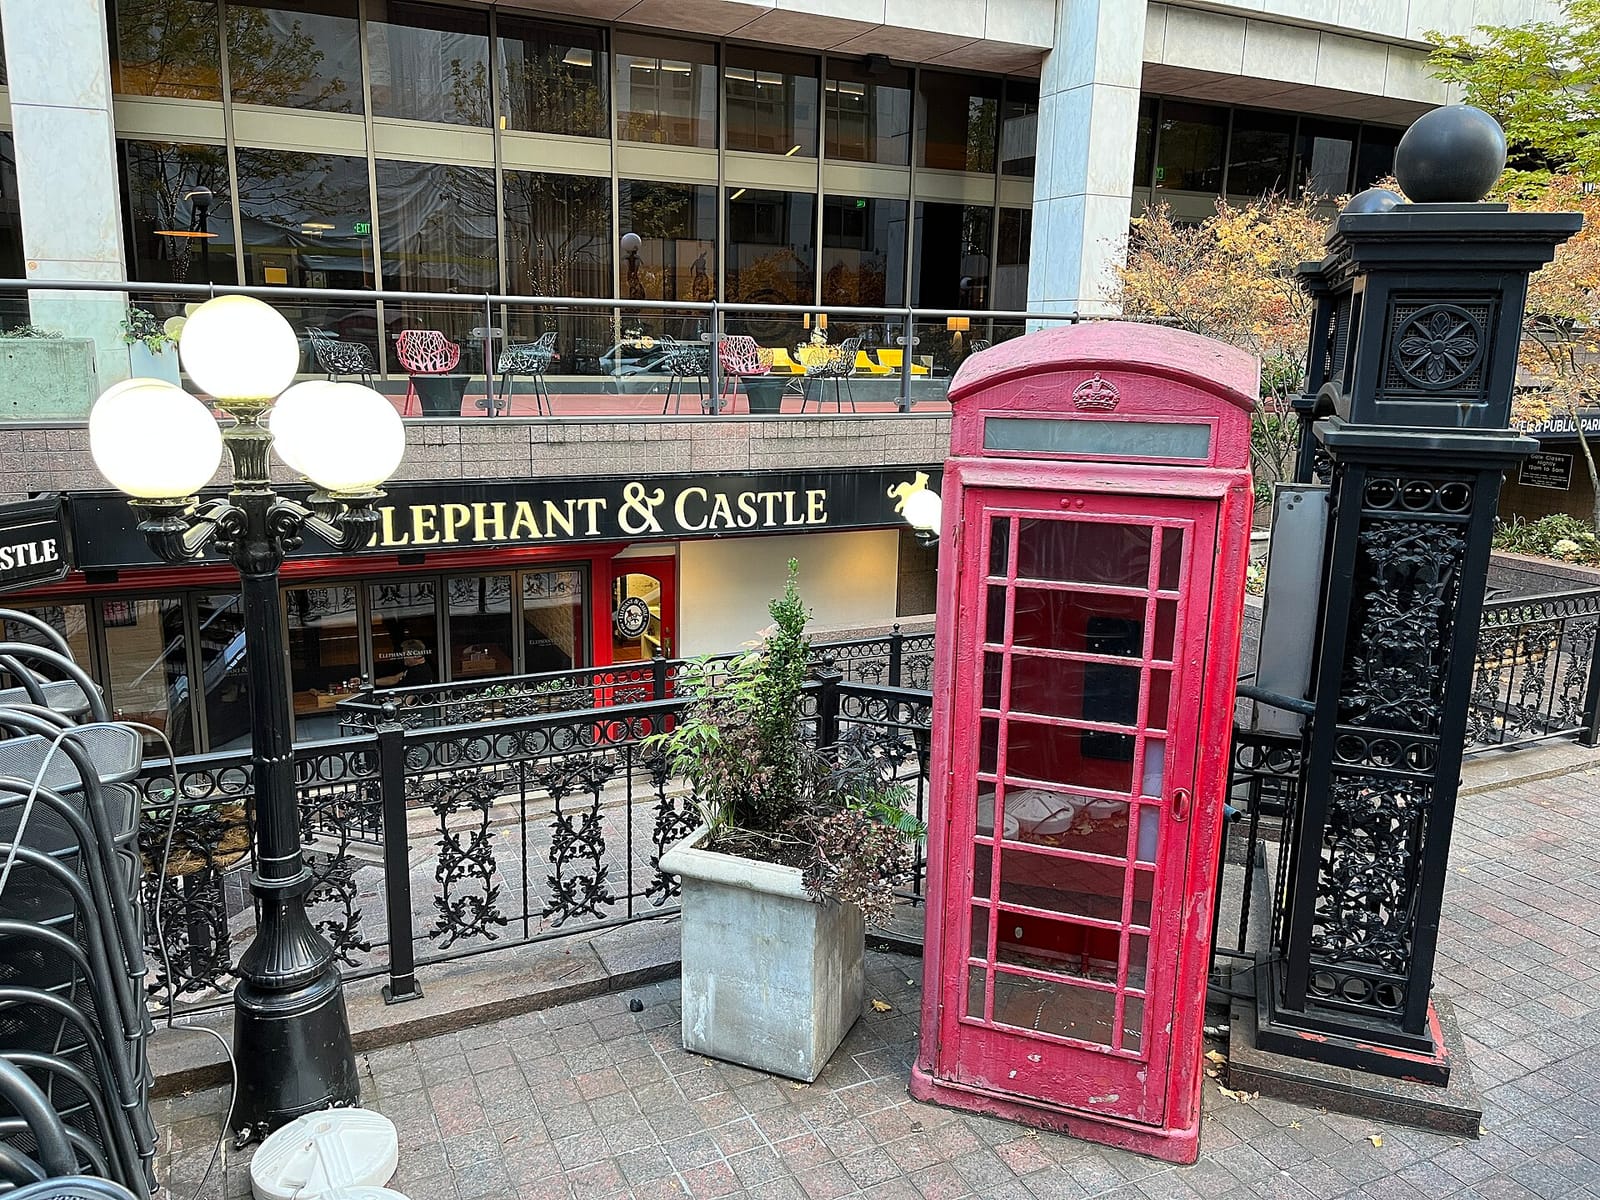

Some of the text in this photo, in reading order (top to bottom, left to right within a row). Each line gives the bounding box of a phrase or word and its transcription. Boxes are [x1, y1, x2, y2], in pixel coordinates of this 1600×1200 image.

[357, 222, 371, 234] EXIT
[1543, 419, 1577, 432] PUBLIC
[1580, 419, 1600, 431] PAR
[366, 482, 828, 547] LEPHANT & CASTLE
[0, 538, 59, 571] STLE
